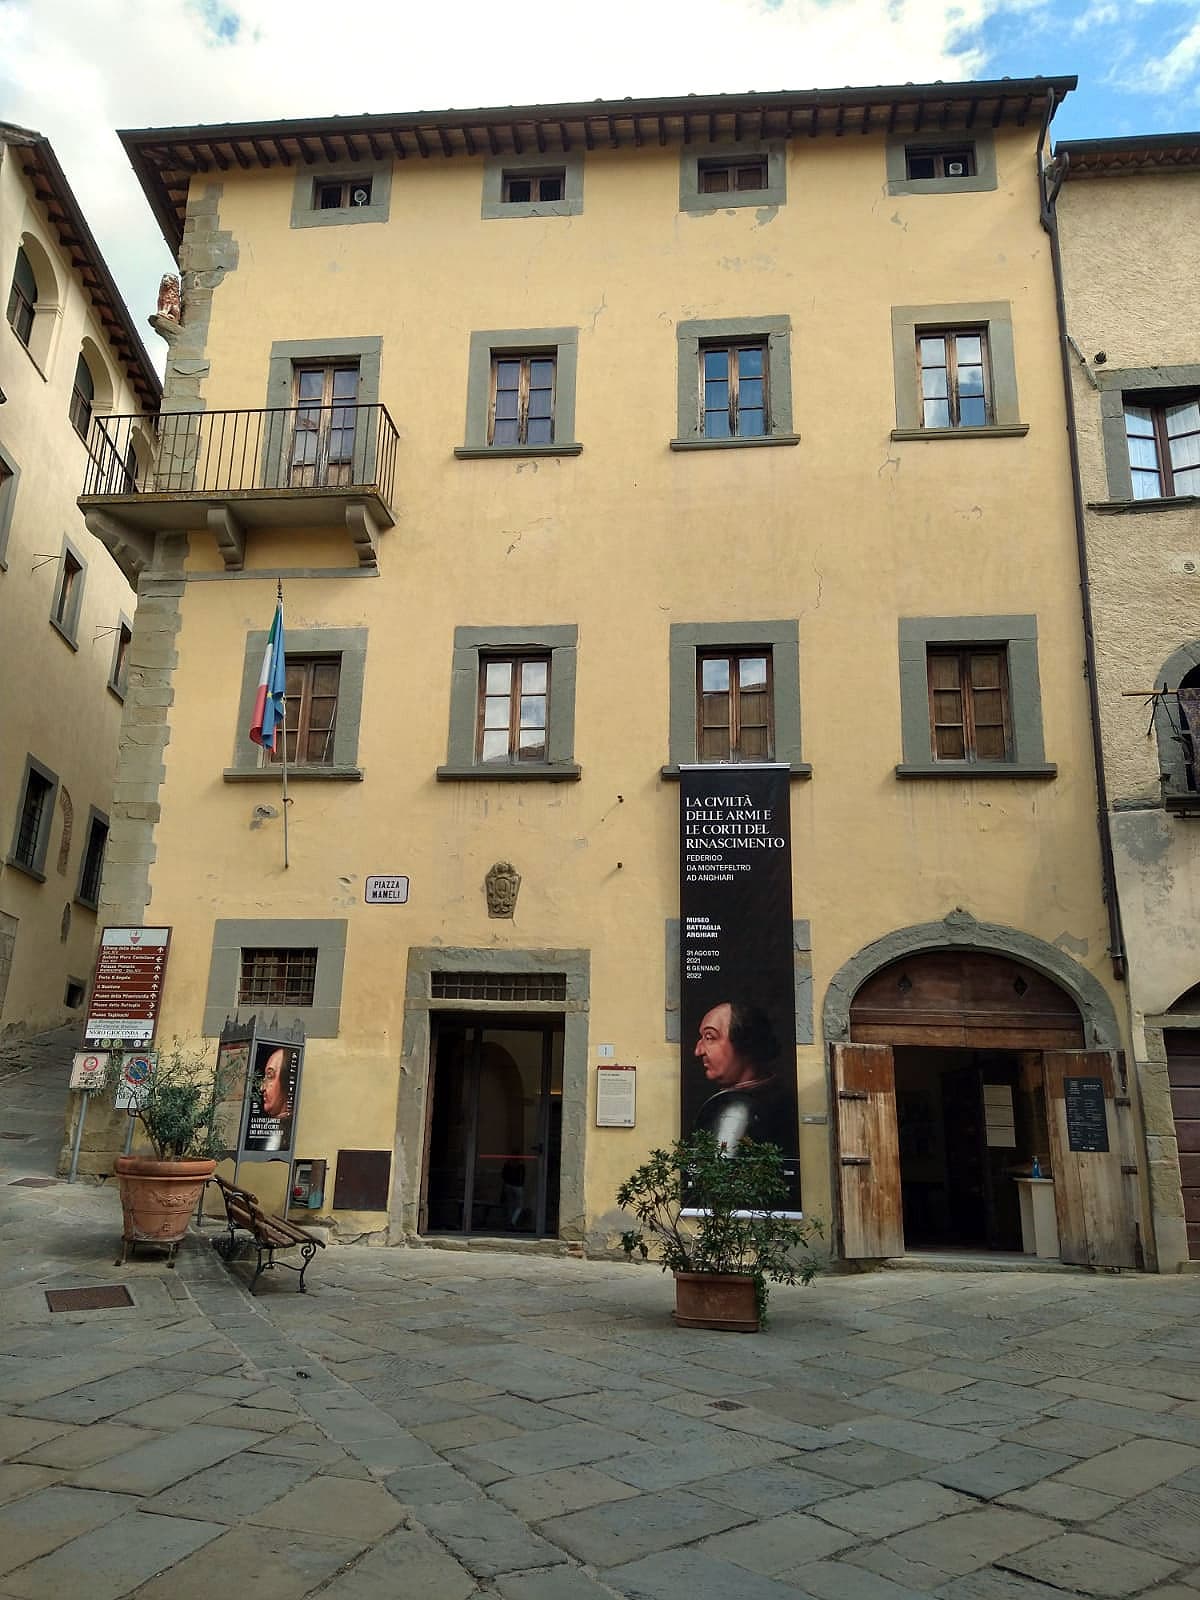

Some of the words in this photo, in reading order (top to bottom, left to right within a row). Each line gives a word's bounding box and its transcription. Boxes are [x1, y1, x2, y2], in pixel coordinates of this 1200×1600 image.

[686, 796, 702, 807] LA
[704, 794, 752, 807] CIVILTÀ
[686, 810, 723, 821] DELLE
[726, 810, 760, 820] ARMI
[764, 810, 772, 820] E
[686, 825, 700, 835] LE
[702, 824, 742, 835] CORTI
[745, 824, 770, 834] DEL
[686, 838, 785, 849] RINASCIMENTO
[686, 854, 723, 862] FEDERICO
[686, 864, 697, 872] DA
[374, 880, 400, 889] PIAZZA
